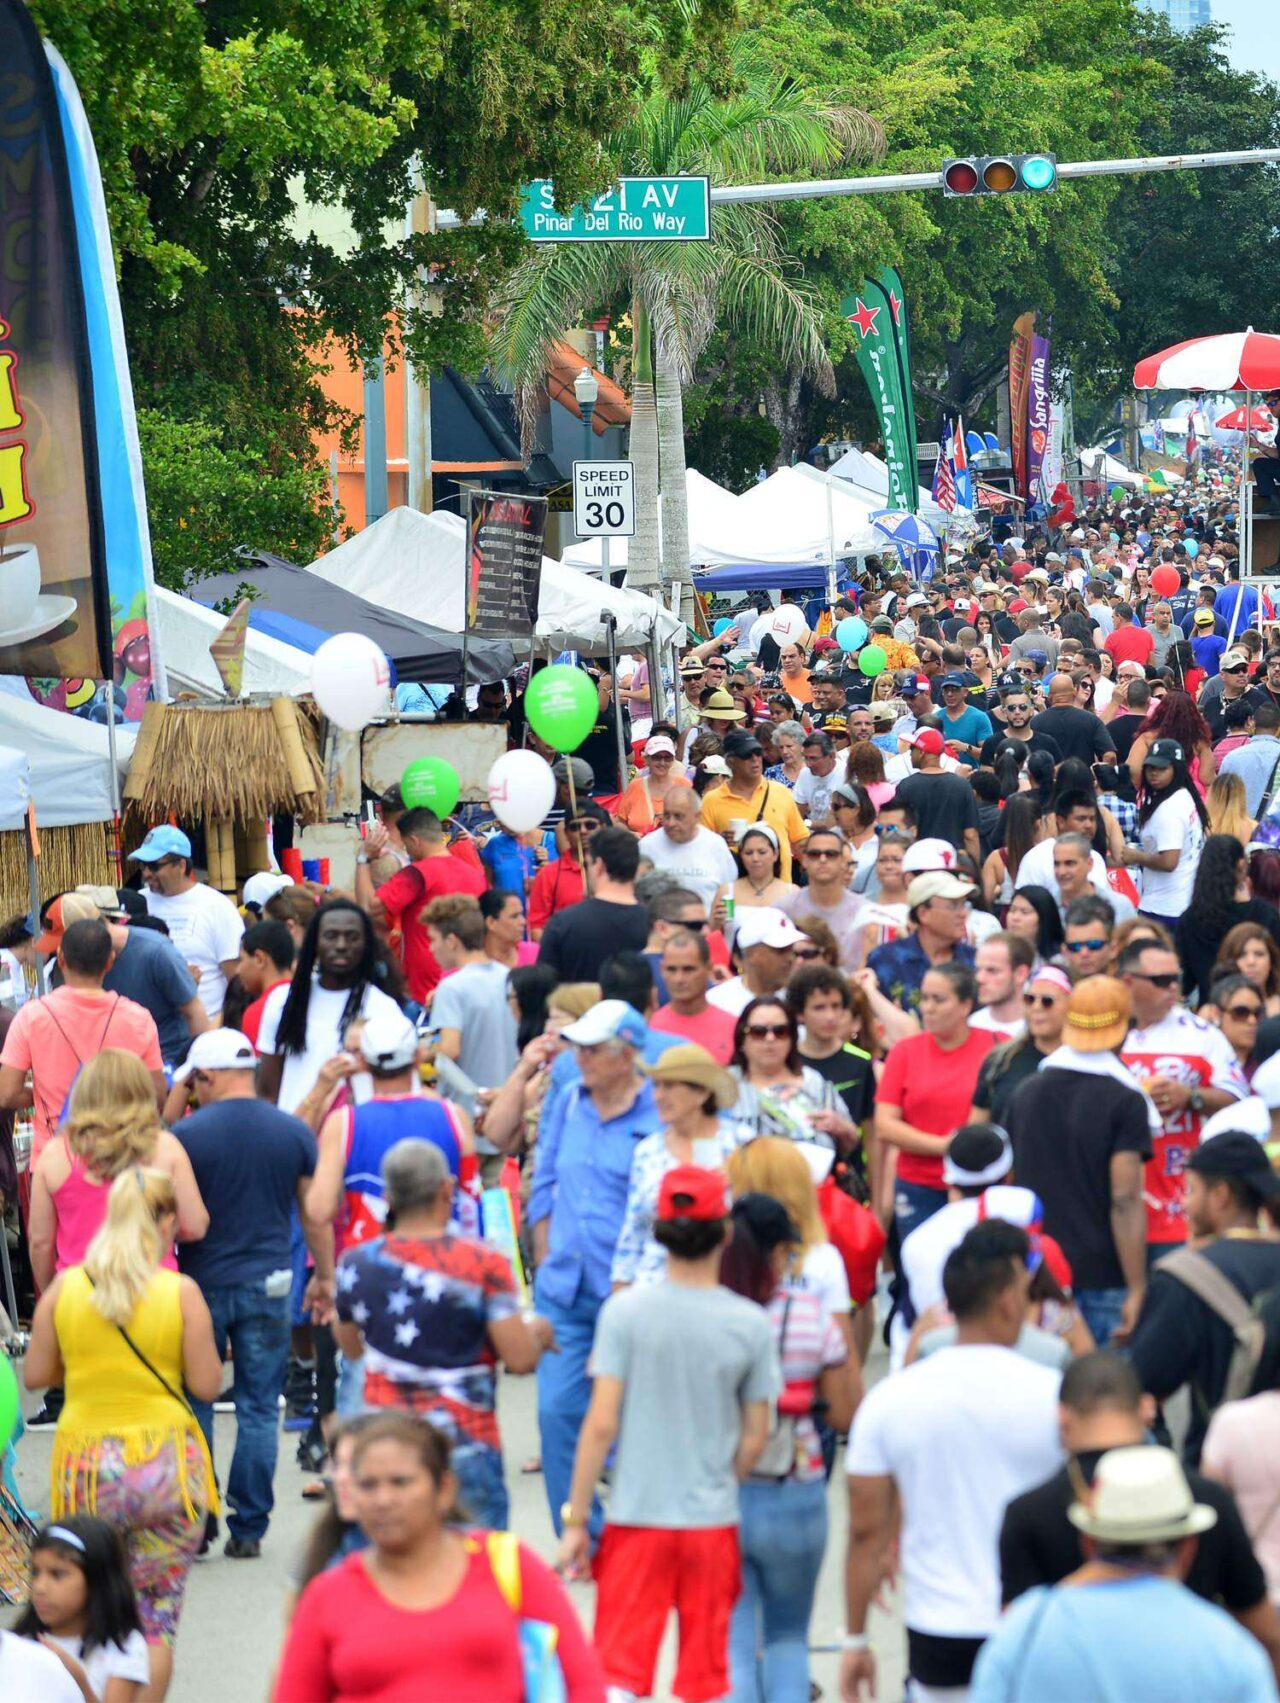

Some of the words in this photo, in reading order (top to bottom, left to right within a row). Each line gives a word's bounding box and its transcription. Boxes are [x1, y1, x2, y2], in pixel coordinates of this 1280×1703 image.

[540, 184, 555, 209] S
[593, 182, 626, 211] 21
[642, 184, 679, 208] AV
[534, 213, 574, 232] Pinar
[585, 213, 609, 231] Del
[618, 213, 643, 231] Rio
[653, 213, 686, 234] Way
[580, 471, 629, 481] SPEED
[585, 486, 622, 496] LIMIT
[586, 502, 624, 527] 30
